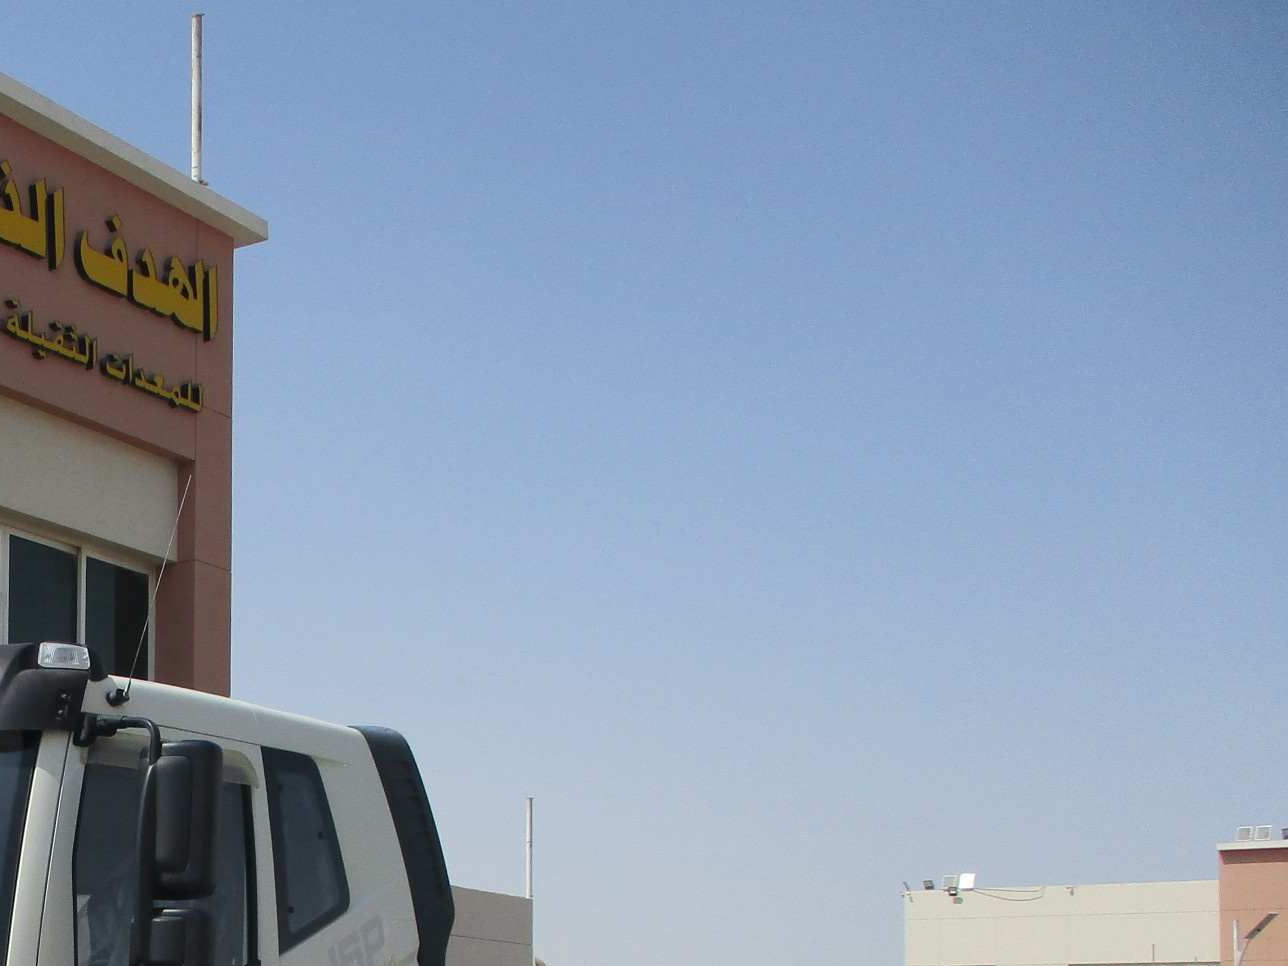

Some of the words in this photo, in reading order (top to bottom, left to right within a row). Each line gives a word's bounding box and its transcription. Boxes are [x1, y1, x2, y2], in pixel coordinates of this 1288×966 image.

[76, 214, 218, 342] الهدف
[0, 297, 98, 370] الثقيلة
[101, 352, 204, 413] للمعدات
